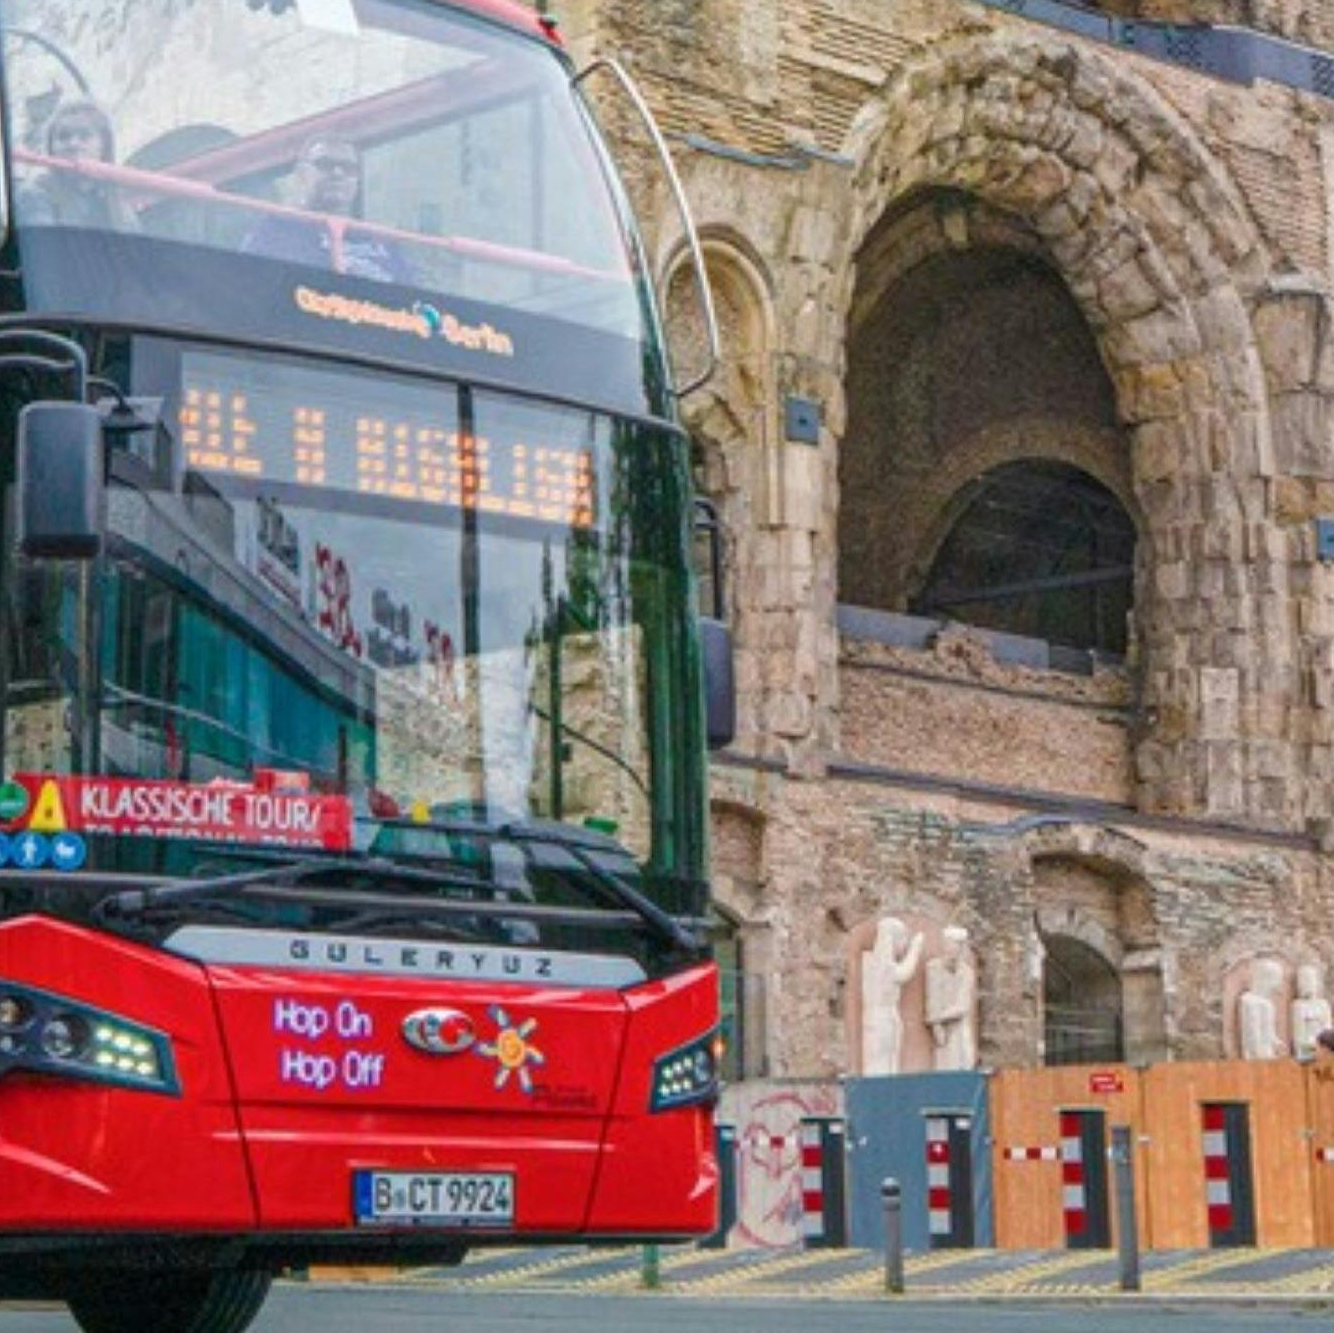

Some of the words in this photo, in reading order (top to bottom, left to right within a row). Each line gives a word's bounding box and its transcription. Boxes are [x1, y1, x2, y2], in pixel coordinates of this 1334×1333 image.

[80, 782, 235, 828] KLASSISCHE
[273, 999, 328, 1039] Hop
[335, 1001, 373, 1037] On
[281, 1049, 336, 1090] Hop
[342, 1050, 385, 1088] Off
